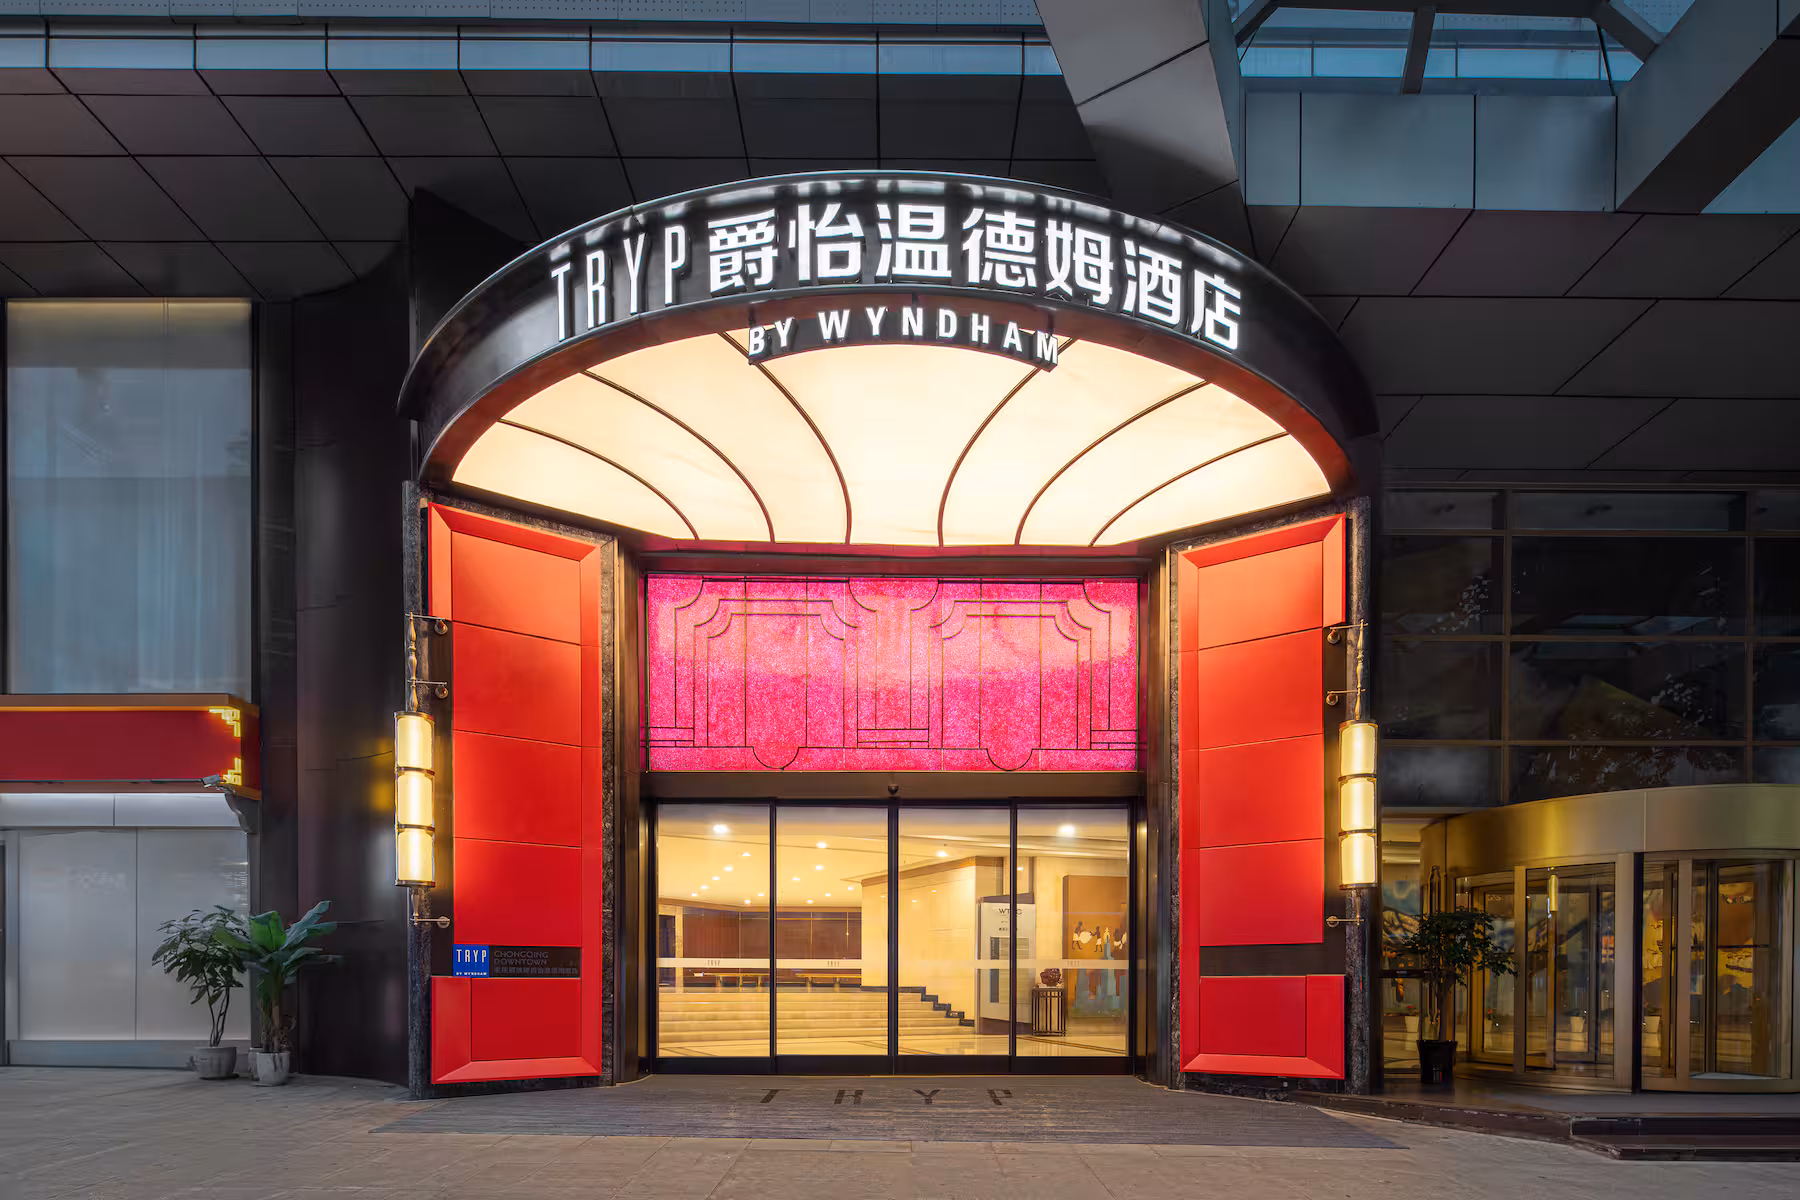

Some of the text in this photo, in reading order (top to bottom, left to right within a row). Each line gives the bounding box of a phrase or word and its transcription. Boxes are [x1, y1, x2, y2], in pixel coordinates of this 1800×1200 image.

[551, 202, 1243, 351] TRYP 爵怡温德姆酒店
[748, 308, 1058, 364] BY WYNDHAM
[456, 949, 487, 963] TRYP
